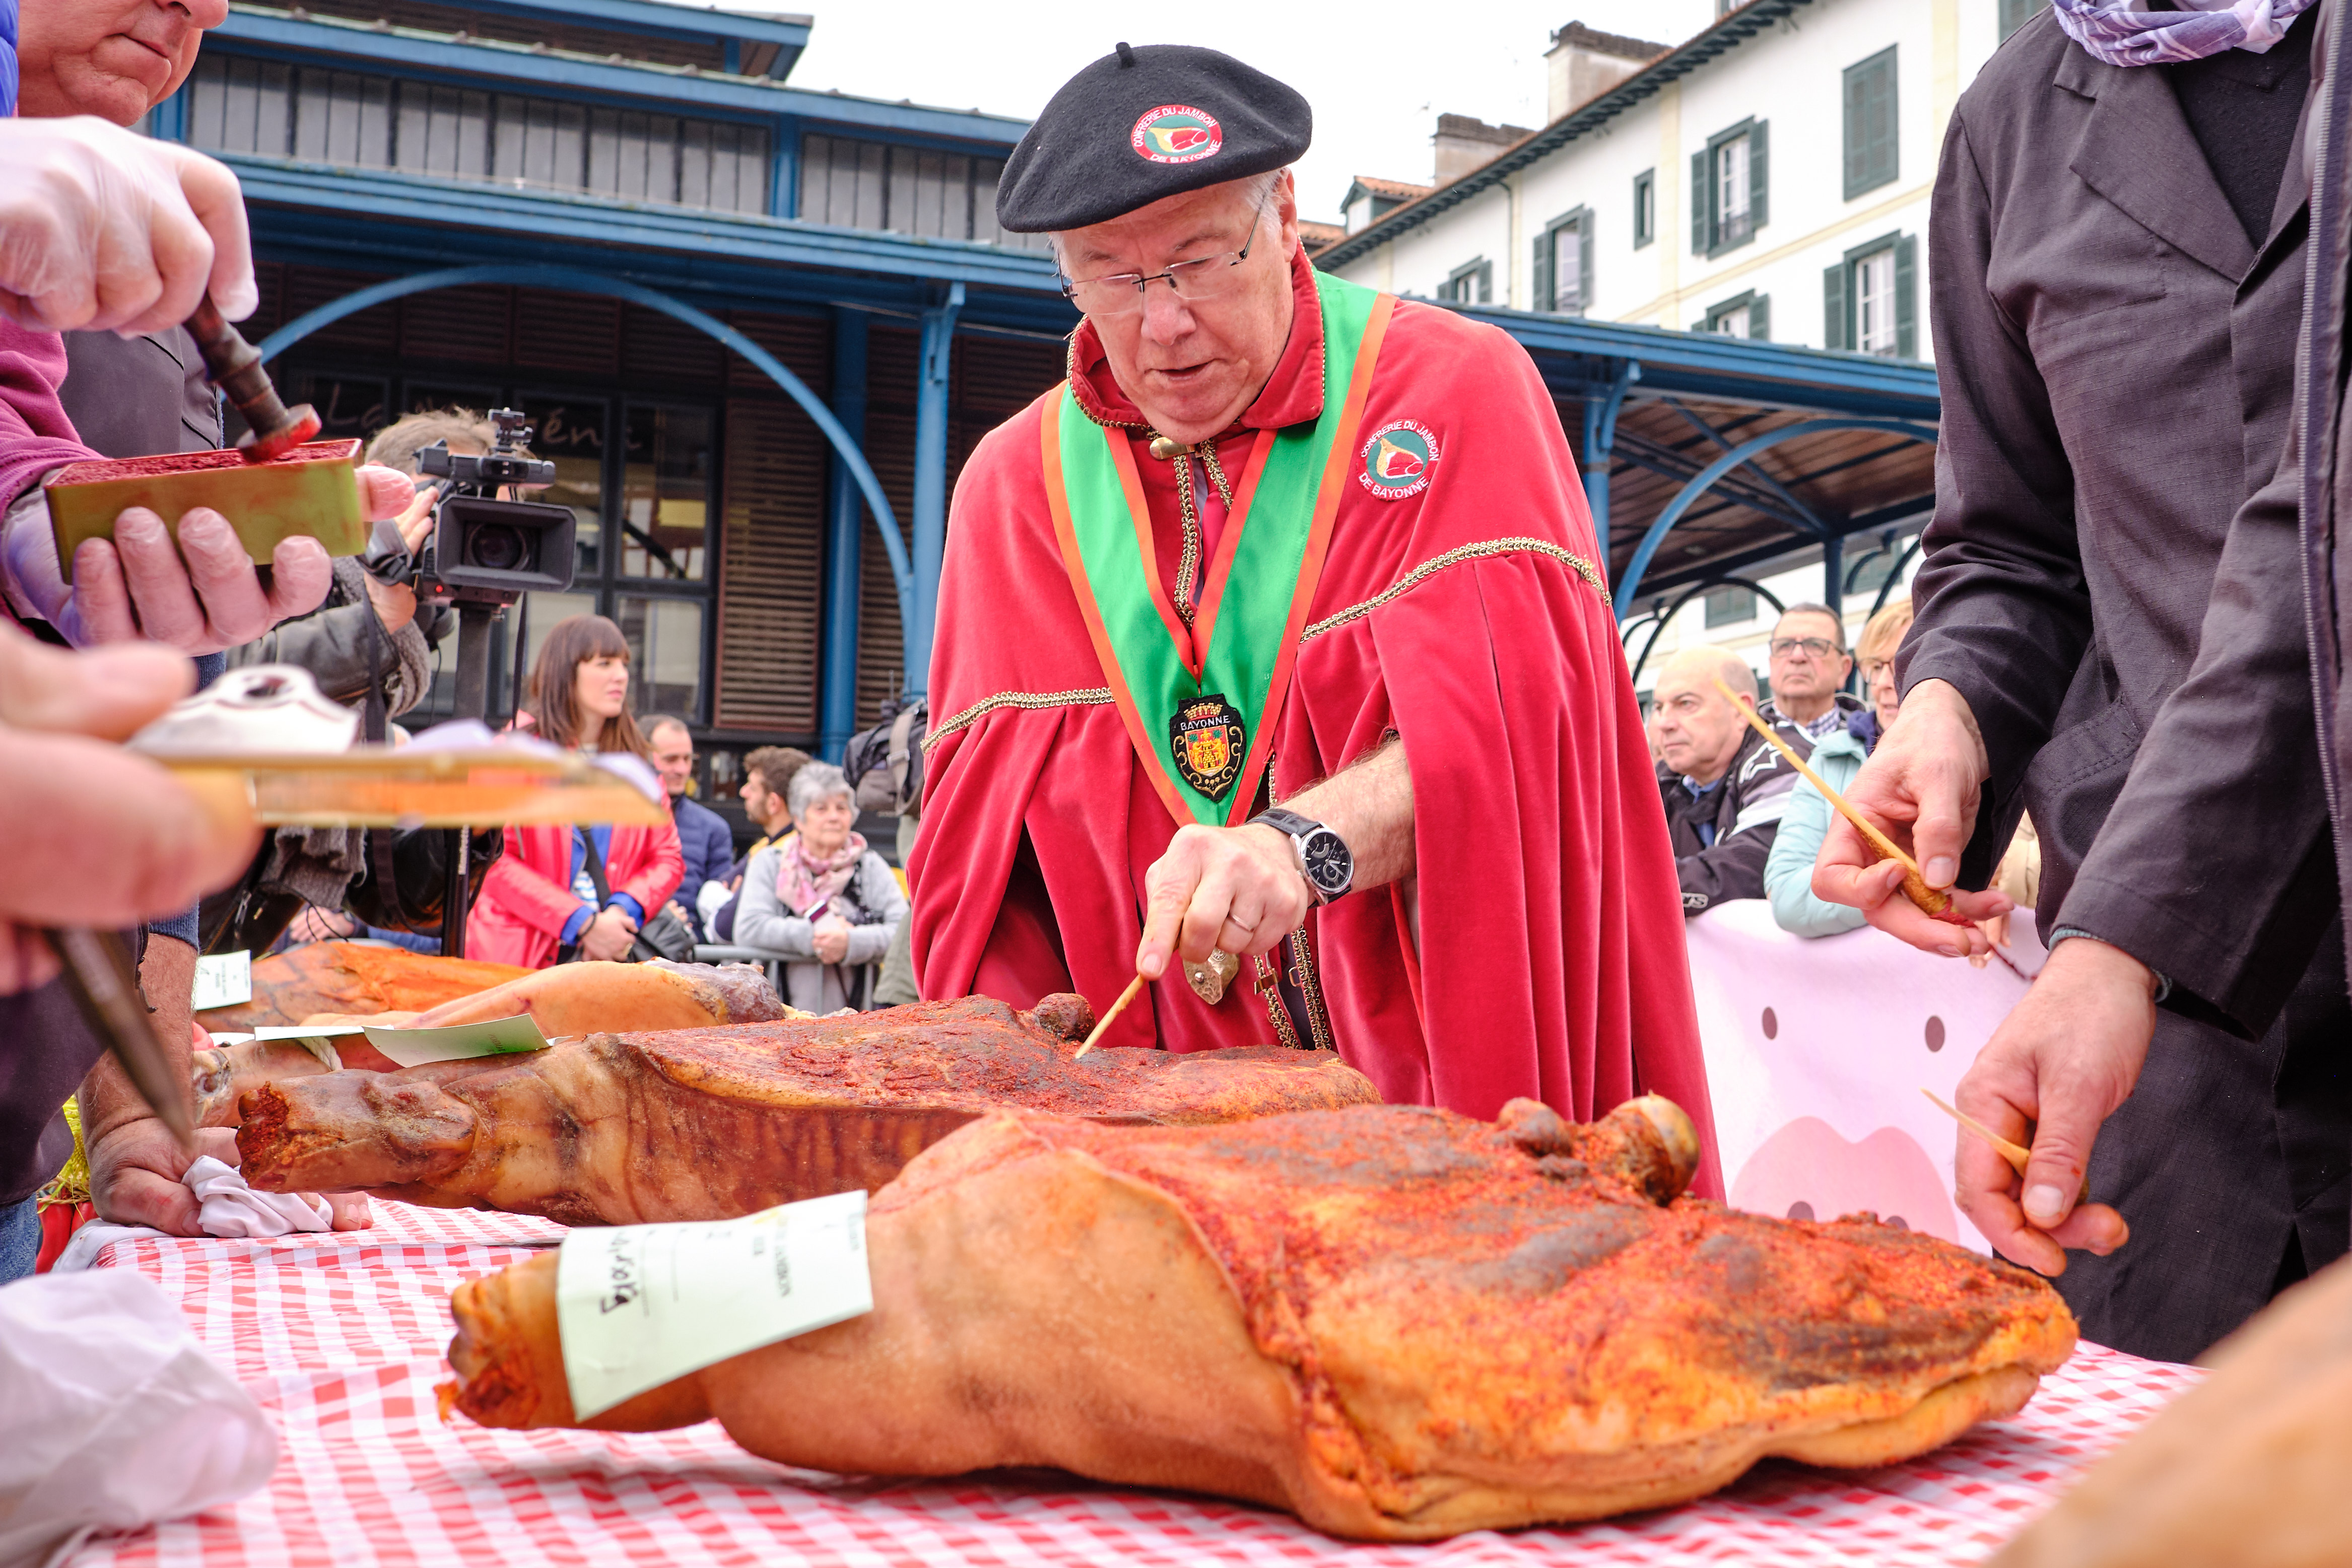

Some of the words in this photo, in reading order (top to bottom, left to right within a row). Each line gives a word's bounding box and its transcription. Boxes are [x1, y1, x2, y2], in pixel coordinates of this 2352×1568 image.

[1133, 110, 1162, 147] CONFRERIE
[1162, 106, 1177, 116] DU
[1178, 107, 1217, 127] JAMBON
[1150, 153, 1167, 163] DE
[1170, 140, 1222, 163] BAYONNE
[1360, 421, 1403, 458] CONFRERIE
[1402, 420, 1418, 429] DU
[1416, 425, 1440, 462] JAMBON
[1358, 472, 1374, 488] DE
[1372, 476, 1429, 498] BAYONNE
[1180, 715, 1230, 730] BAYONNE
